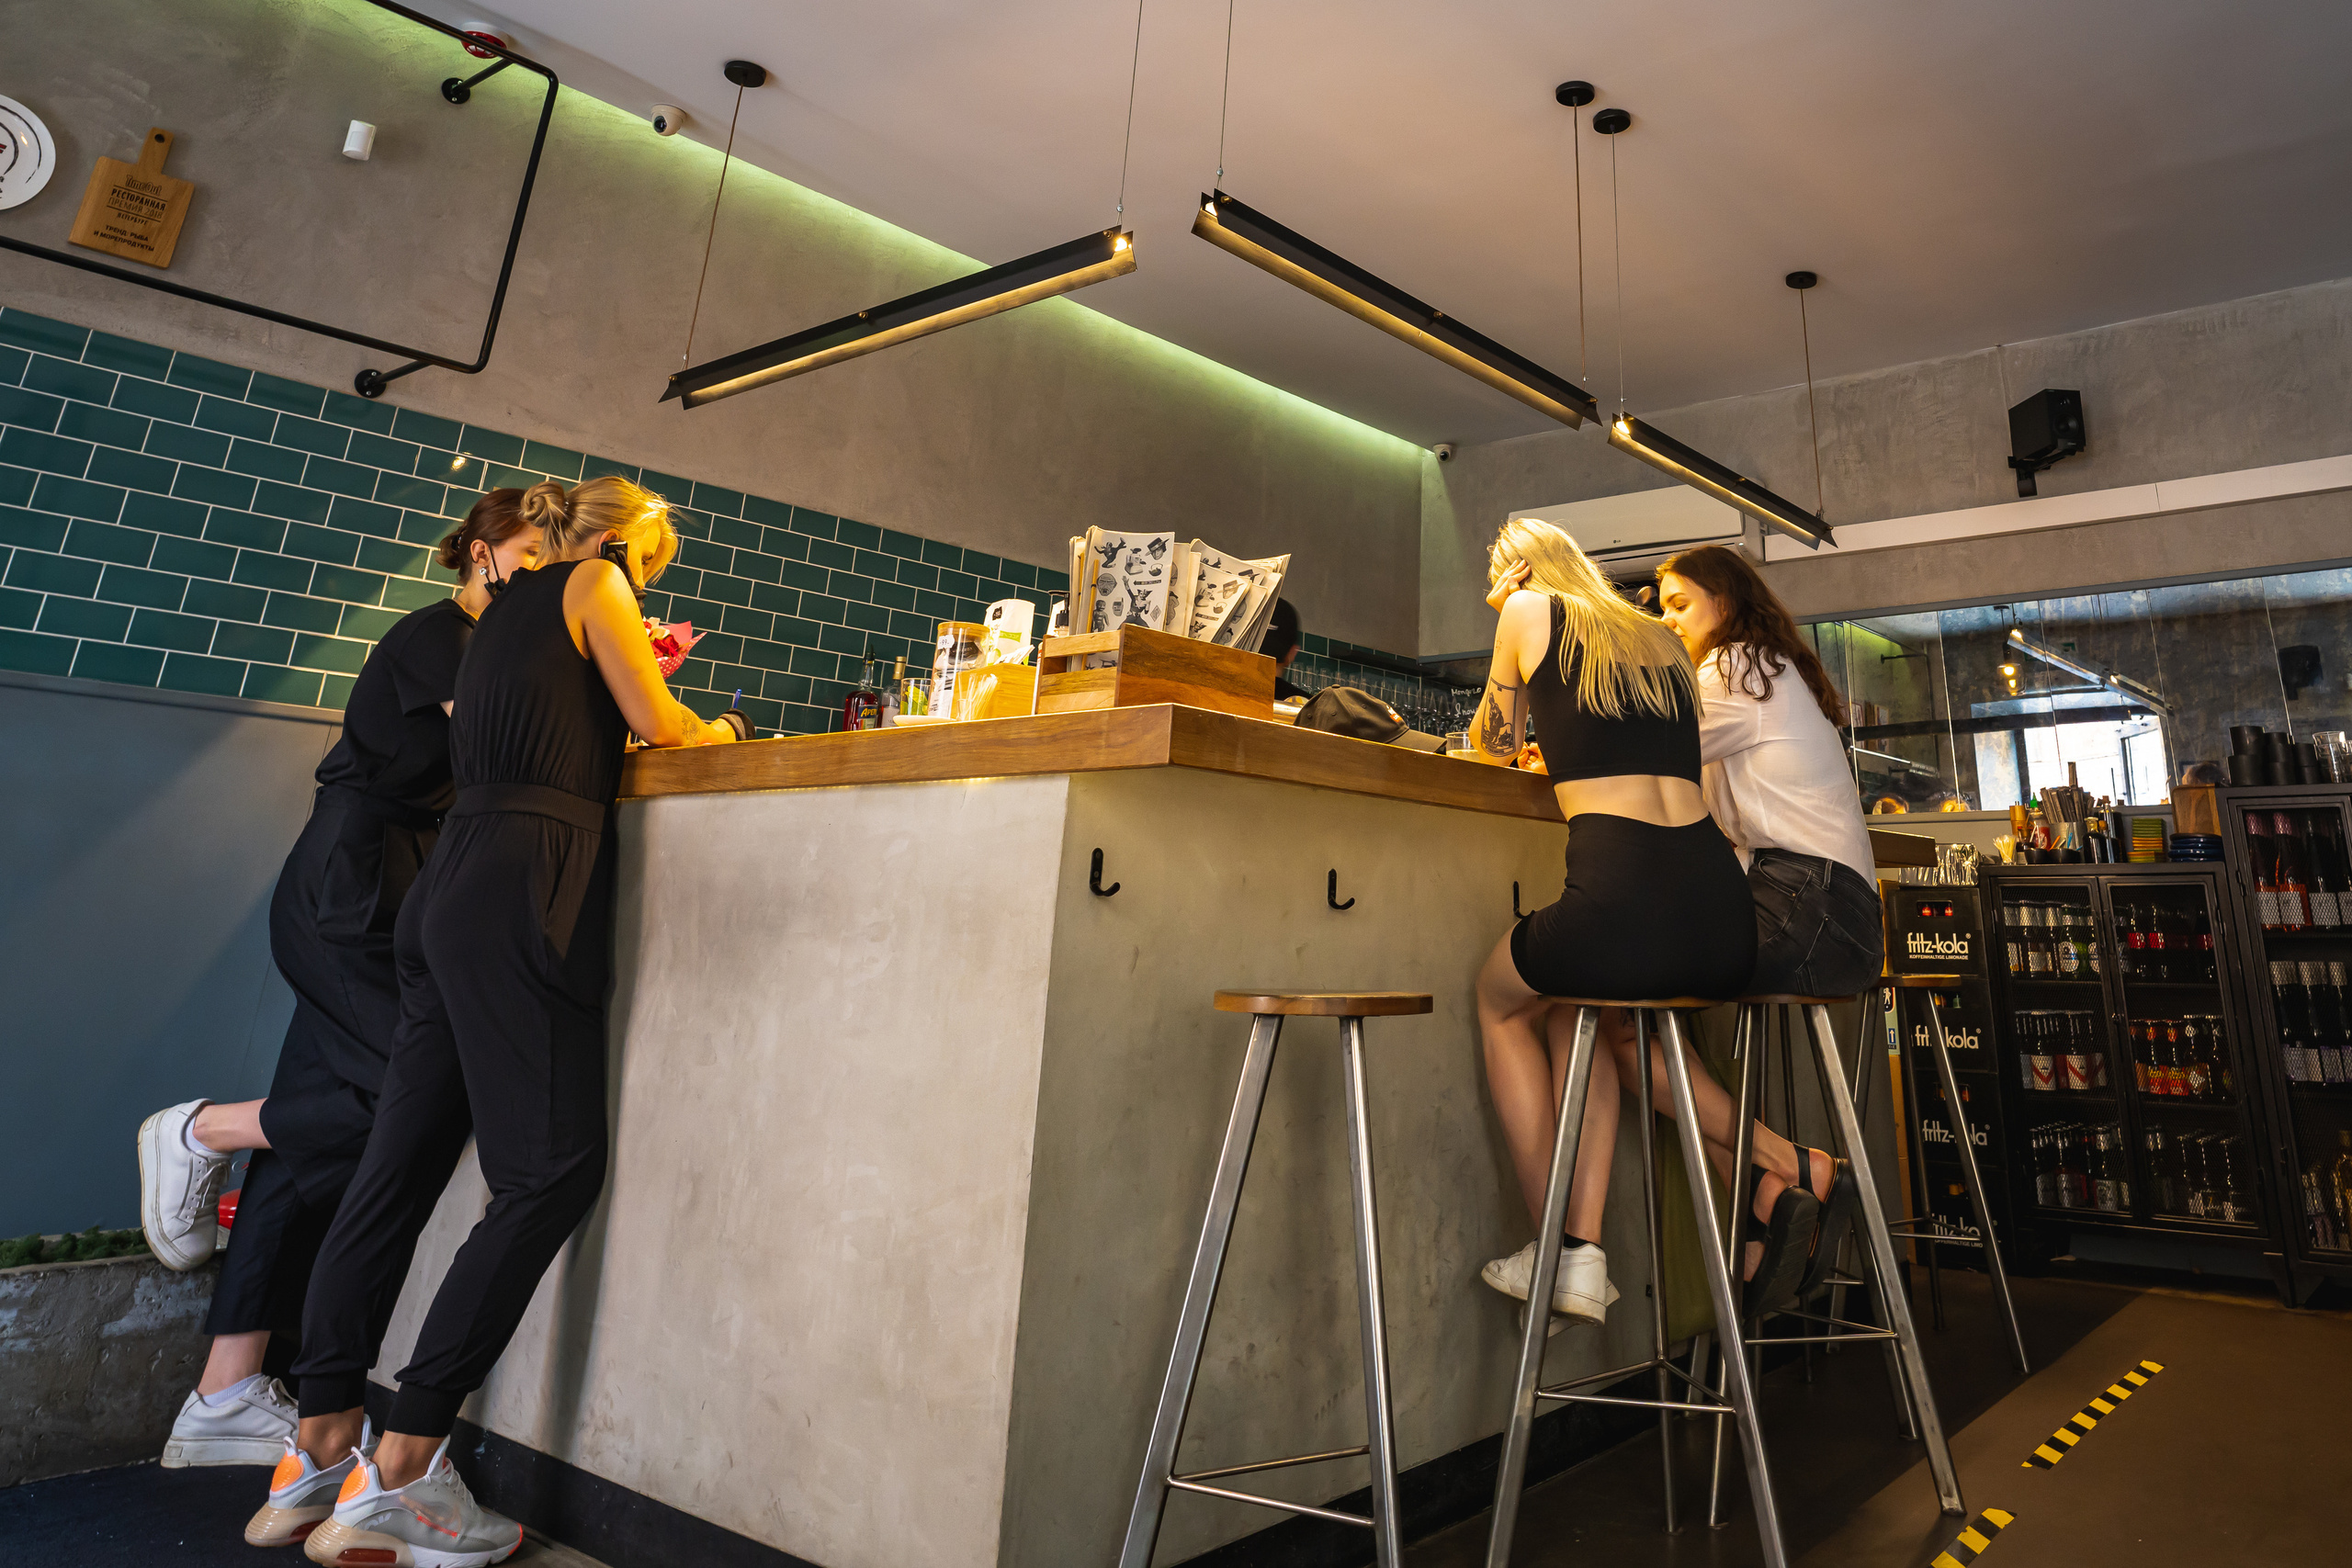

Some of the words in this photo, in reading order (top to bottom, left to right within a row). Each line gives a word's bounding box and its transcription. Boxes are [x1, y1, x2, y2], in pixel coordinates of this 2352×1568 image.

[108, 197, 143, 213] ПРЕМИЯ
[144, 208, 164, 220] 2018
[111, 188, 166, 211] РЕСТОРАННАЯ
[117, 211, 148, 226] ПЕТЕРБУРГ
[99, 231, 155, 252] МОРЕПРОДУКТЫ
[130, 231, 149, 242] РЫБА
[1906, 931, 1969, 953] fritz-kola
